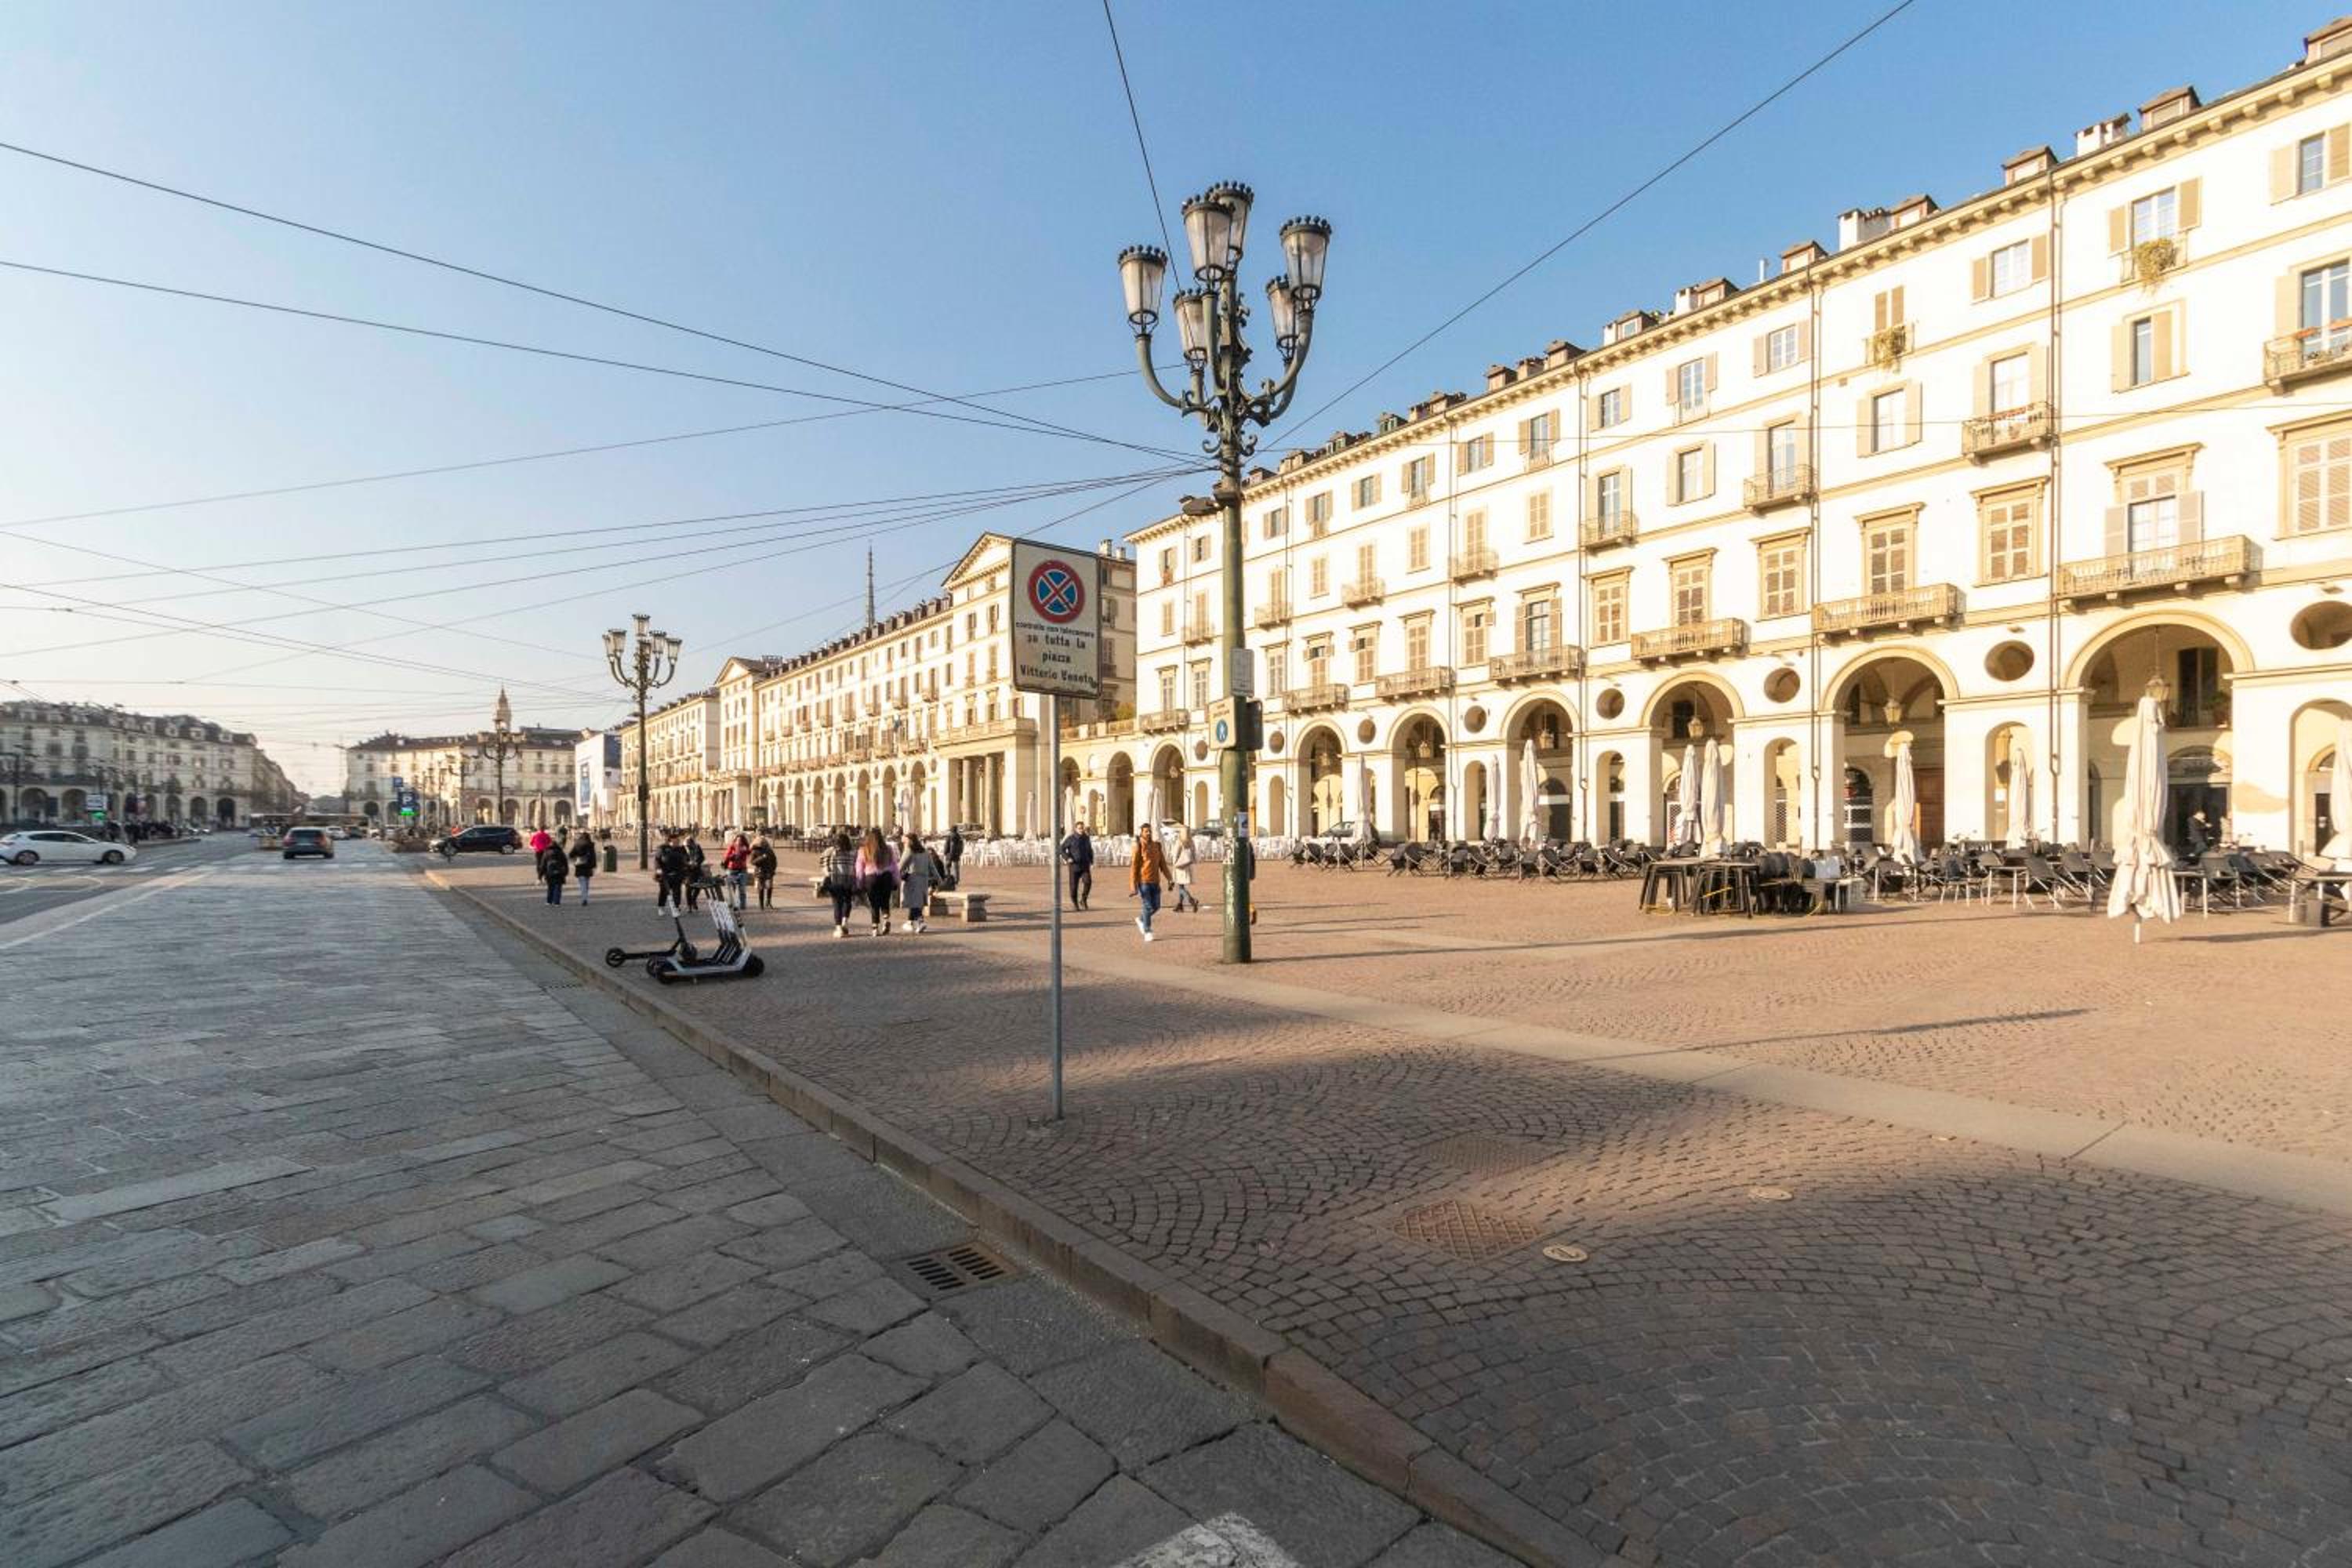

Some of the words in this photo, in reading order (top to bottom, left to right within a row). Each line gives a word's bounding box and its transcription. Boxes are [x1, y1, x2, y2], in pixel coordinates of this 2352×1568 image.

[1045, 633, 1070, 647] tutta
[1076, 637, 1086, 649] la
[1043, 651, 1070, 664] piazza
[1020, 664, 1058, 680] Vittorio
[1061, 670, 1094, 684] Veneto
